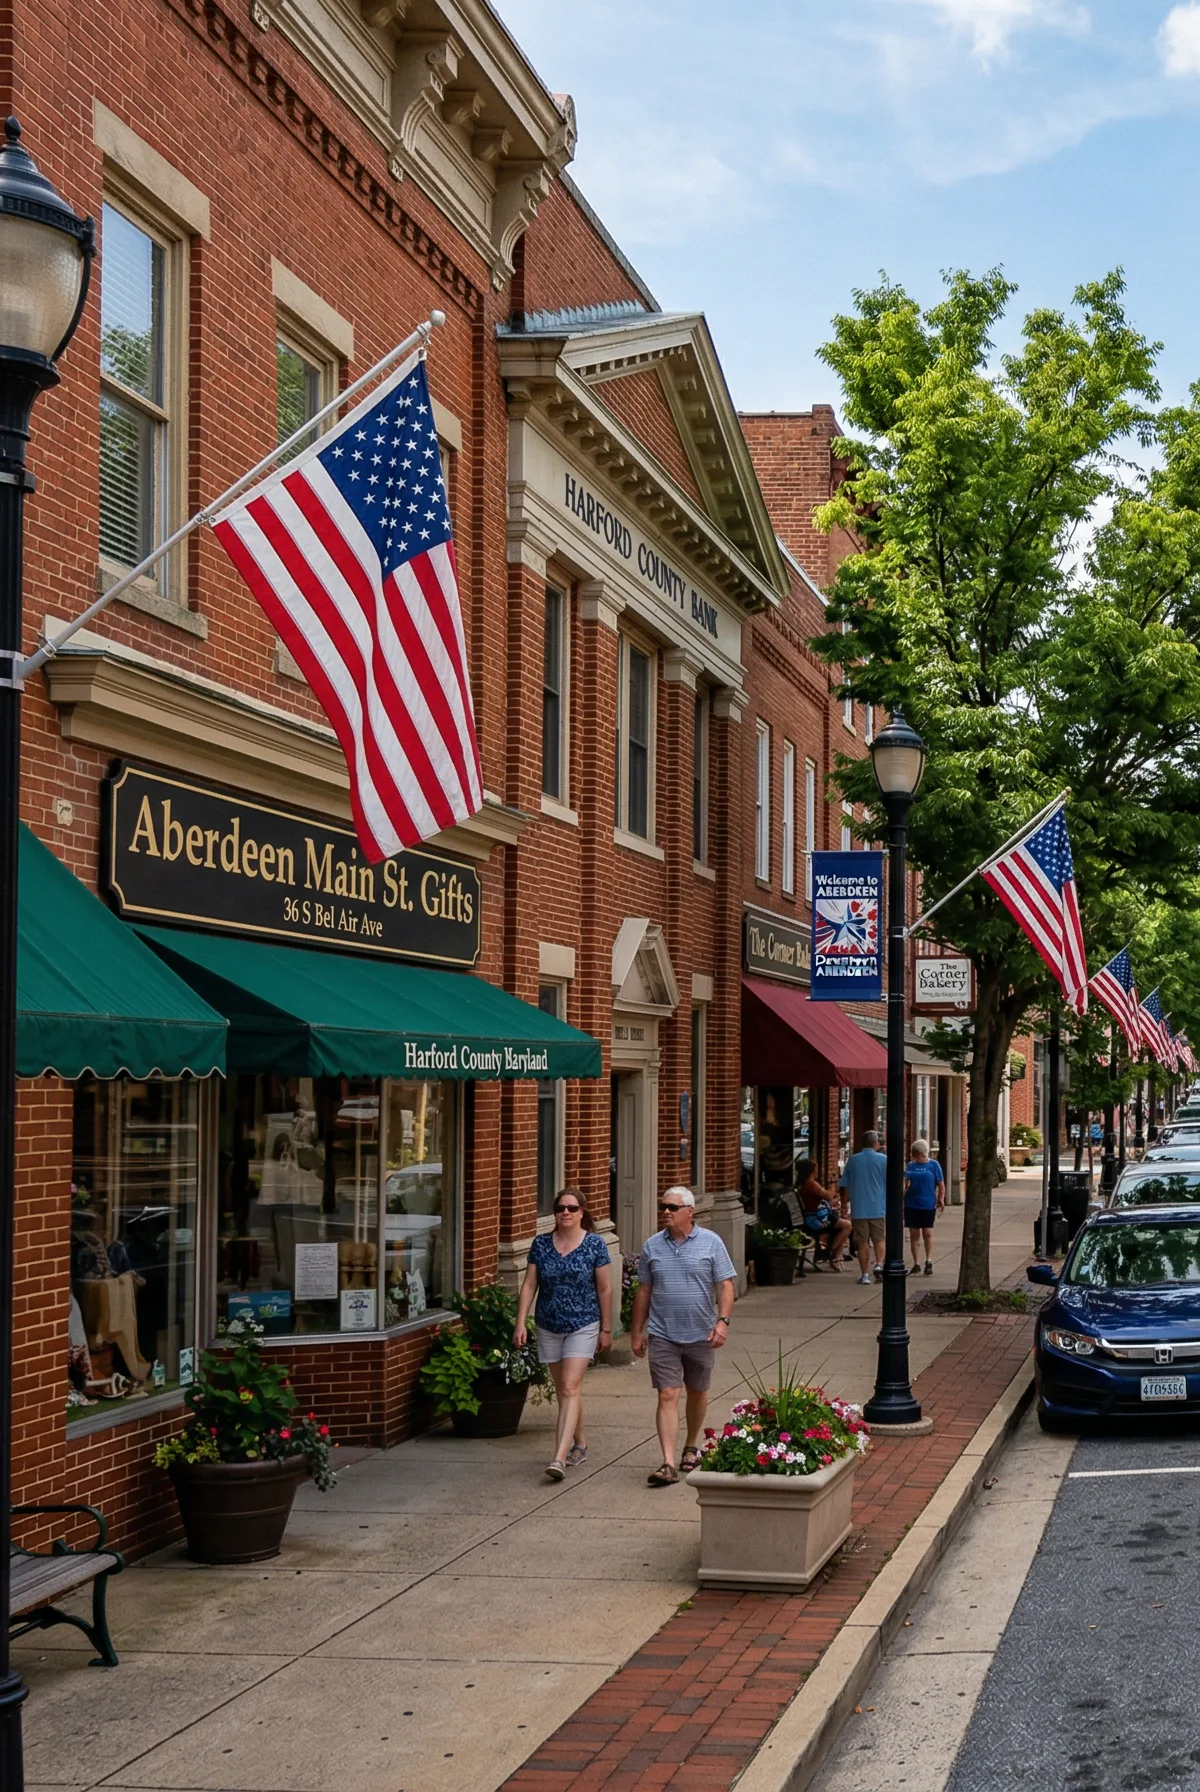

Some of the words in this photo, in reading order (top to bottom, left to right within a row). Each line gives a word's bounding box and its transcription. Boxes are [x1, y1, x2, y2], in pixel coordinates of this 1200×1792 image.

[565, 473, 632, 559] HARFORD
[638, 543, 686, 609] COUNTY
[691, 589, 719, 639] BANK
[128, 794, 296, 886] Aberdeen
[304, 837, 375, 903] Main
[383, 859, 413, 912] St.
[420, 870, 473, 924] Gifts
[283, 897, 299, 922] 36
[302, 901, 311, 925] S
[314, 902, 335, 928] Bel
[338, 908, 358, 932] Air
[361, 913, 383, 938] Ave
[919, 976, 966, 991] Bakery
[404, 1042, 458, 1069] Harford
[461, 1045, 502, 1076] County
